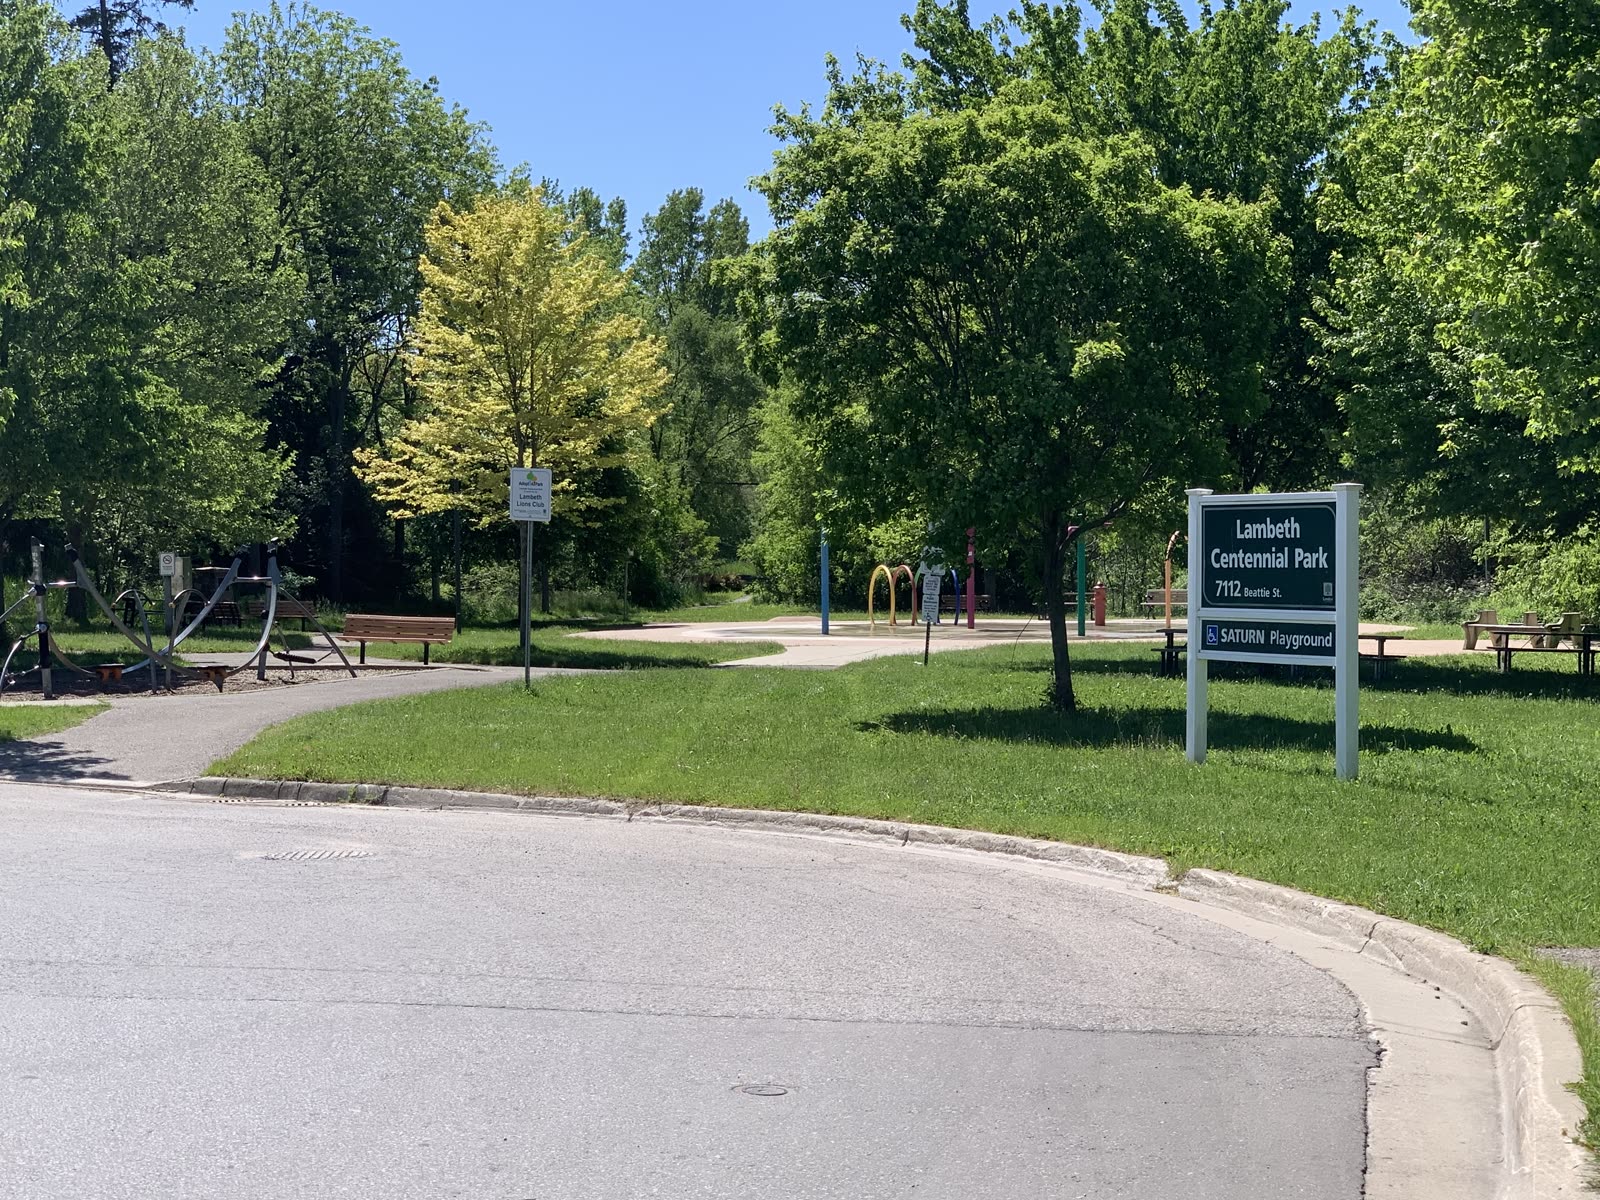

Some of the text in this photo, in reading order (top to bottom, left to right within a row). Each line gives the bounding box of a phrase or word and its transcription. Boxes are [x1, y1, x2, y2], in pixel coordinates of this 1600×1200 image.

[1236, 517, 1300, 539] Lambeth
[1211, 547, 1328, 568] Centennial Park
[1216, 580, 1282, 598] 7112 Beattie St.
[1221, 628, 1333, 650] SATURN Playground
